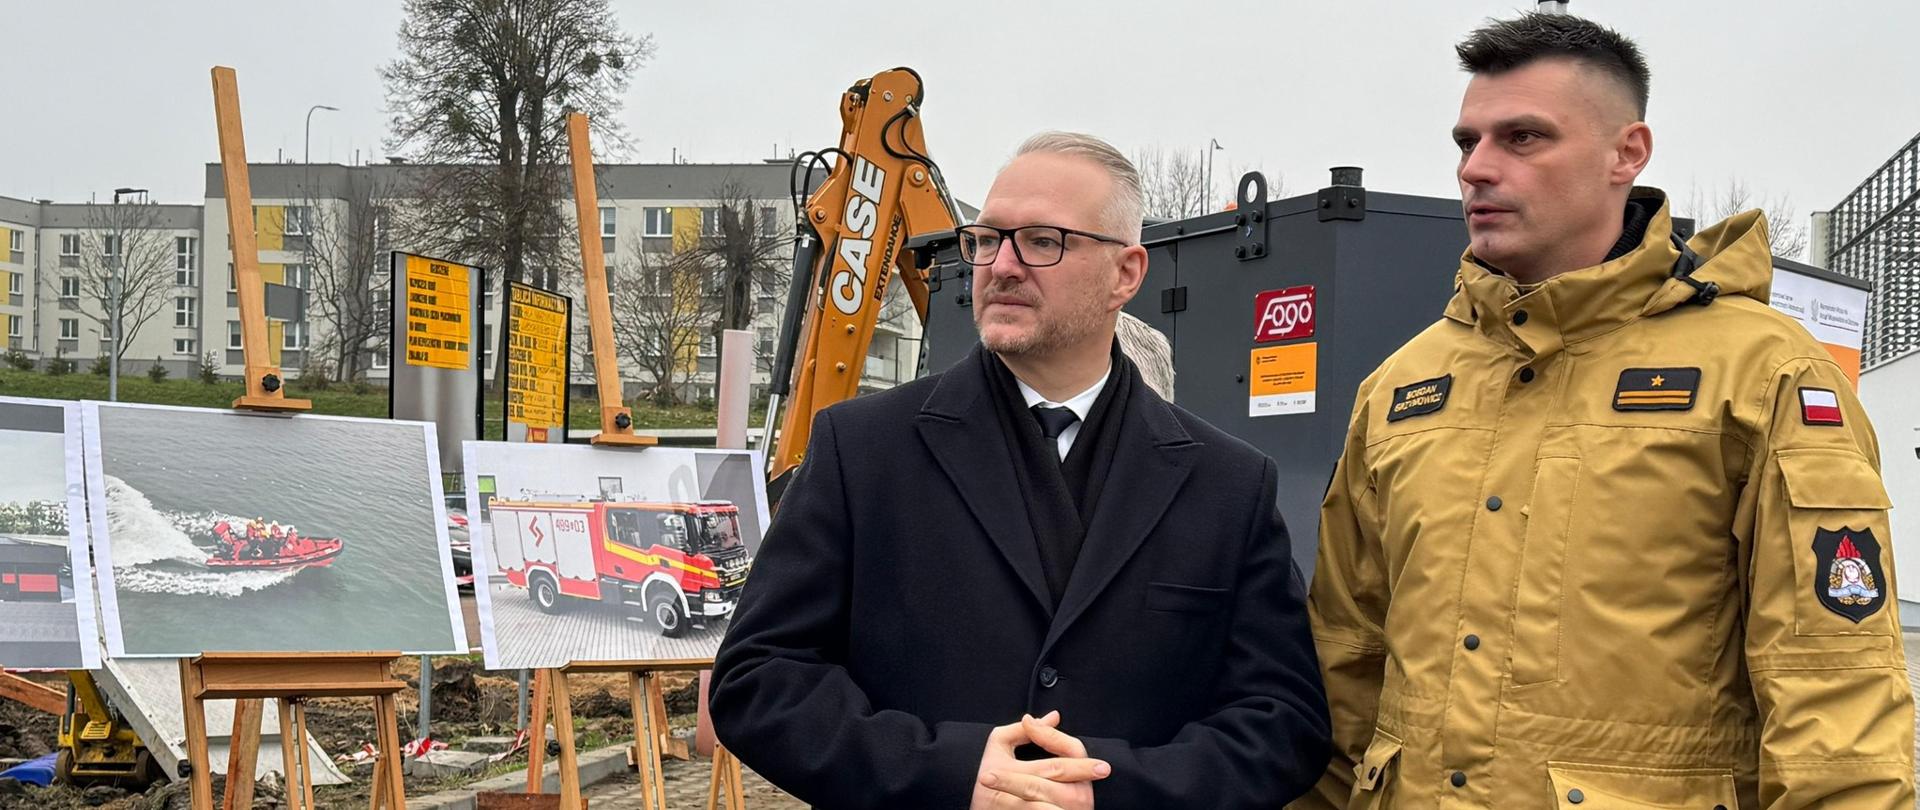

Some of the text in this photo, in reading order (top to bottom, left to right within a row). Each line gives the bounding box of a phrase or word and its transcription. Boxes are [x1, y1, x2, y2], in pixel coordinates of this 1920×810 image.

[831, 154, 887, 316] CASE
[873, 213, 903, 302] EXTENDAHOE
[1405, 384, 1438, 401] BOGDAN
